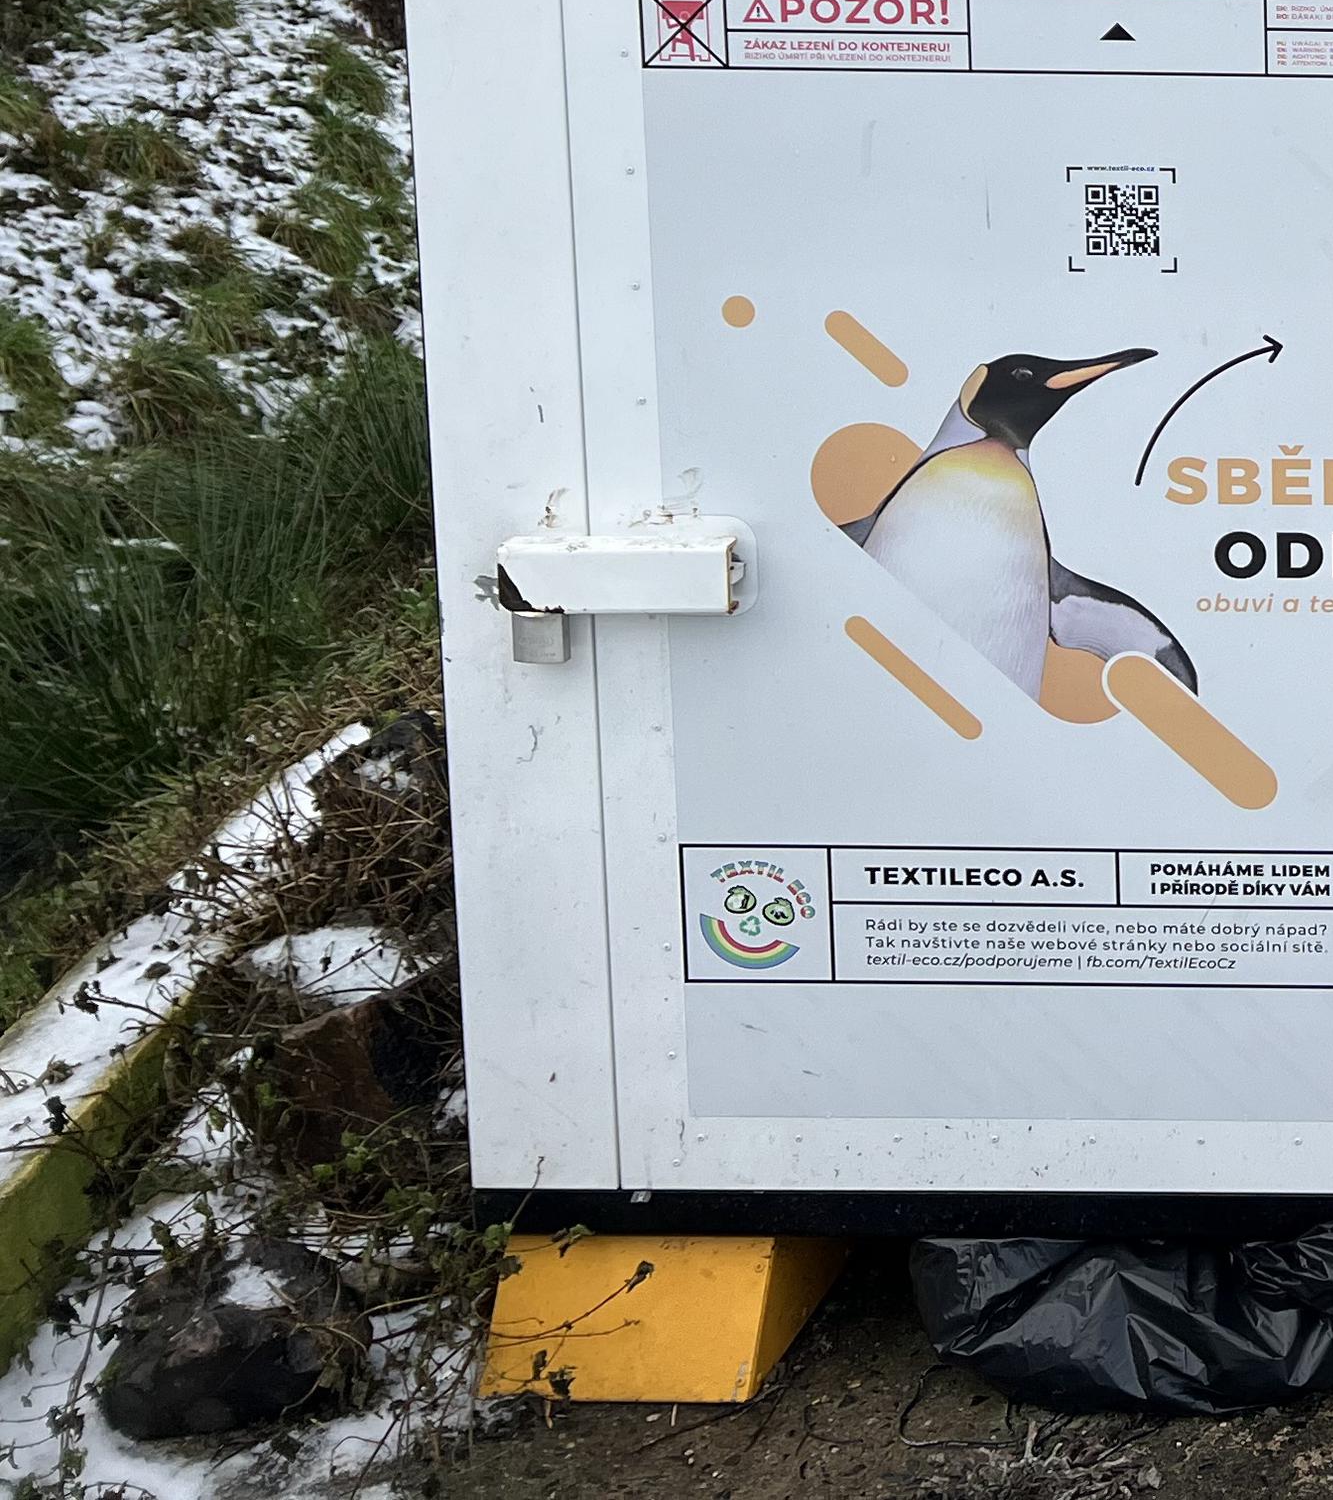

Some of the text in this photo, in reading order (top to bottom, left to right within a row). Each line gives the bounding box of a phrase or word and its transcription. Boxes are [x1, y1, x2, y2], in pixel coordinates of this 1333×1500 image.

[744, 38, 950, 53] ZÁKAZ LEZENÍ DO KONTEJNERU!
[744, 52, 776, 60] RIZIKO
[869, 54, 883, 62] DO
[885, 54, 950, 63] KONTEJNERU!
[1197, 593, 1273, 612] obuvi
[1283, 599, 1299, 612] a
[865, 867, 1083, 887] TEXTILECO A.S.
[1151, 861, 1331, 878] POMÁHÁME LIDEM
[1150, 880, 1330, 896] I PŘÍRODĚ DÍKY VÁM
[865, 918, 1326, 937] Rádi by ste se dozvědeli více, nebo máte dobrý nápad?
[865, 936, 1329, 955] Tak navštivte naše webové stránky nebo sociální sítě.
[867, 953, 1072, 969] textil-eco.cz/podporujeme
[1086, 956, 1237, 970] fb.com/TextilEcoCz
